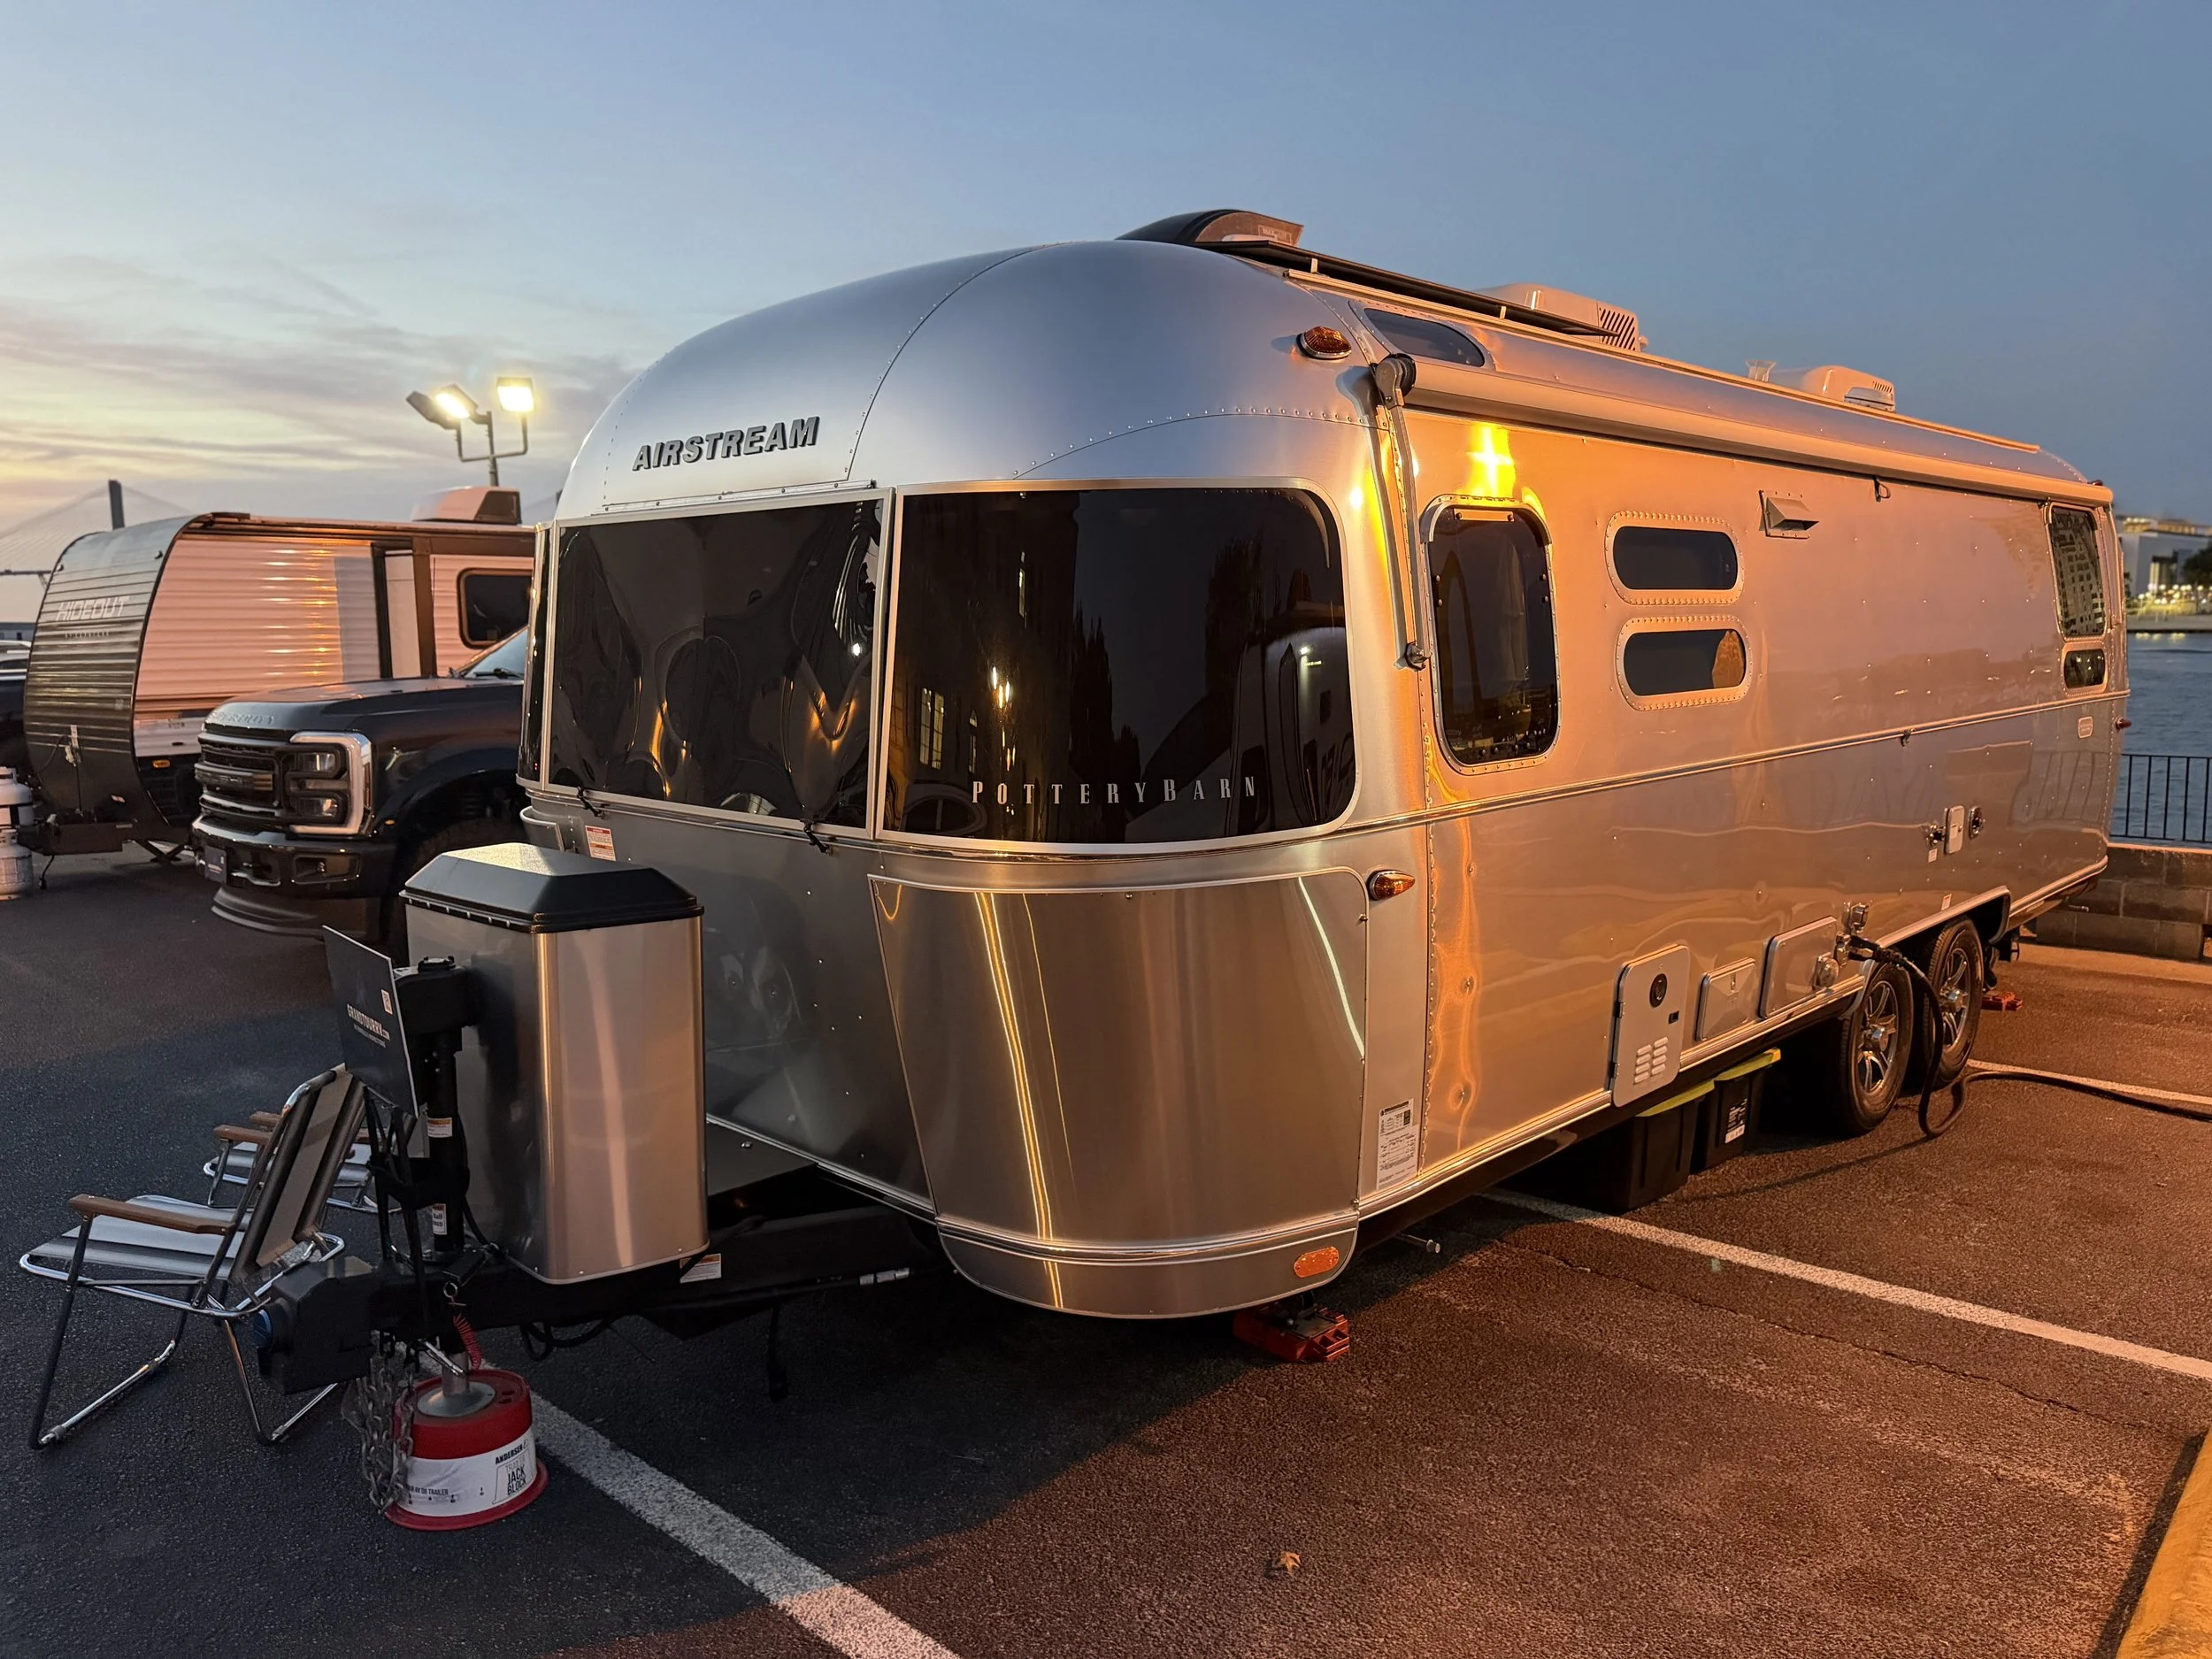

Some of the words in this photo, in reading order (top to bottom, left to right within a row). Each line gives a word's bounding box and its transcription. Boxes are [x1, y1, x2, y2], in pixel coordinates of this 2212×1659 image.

[632, 416, 820, 472] AIRSTREAM
[56, 596, 130, 621] HIDEOUT
[495, 1444, 523, 1464] ANDERSEN
[507, 1464, 526, 1484] JACK
[507, 1477, 526, 1496] BLOCK
